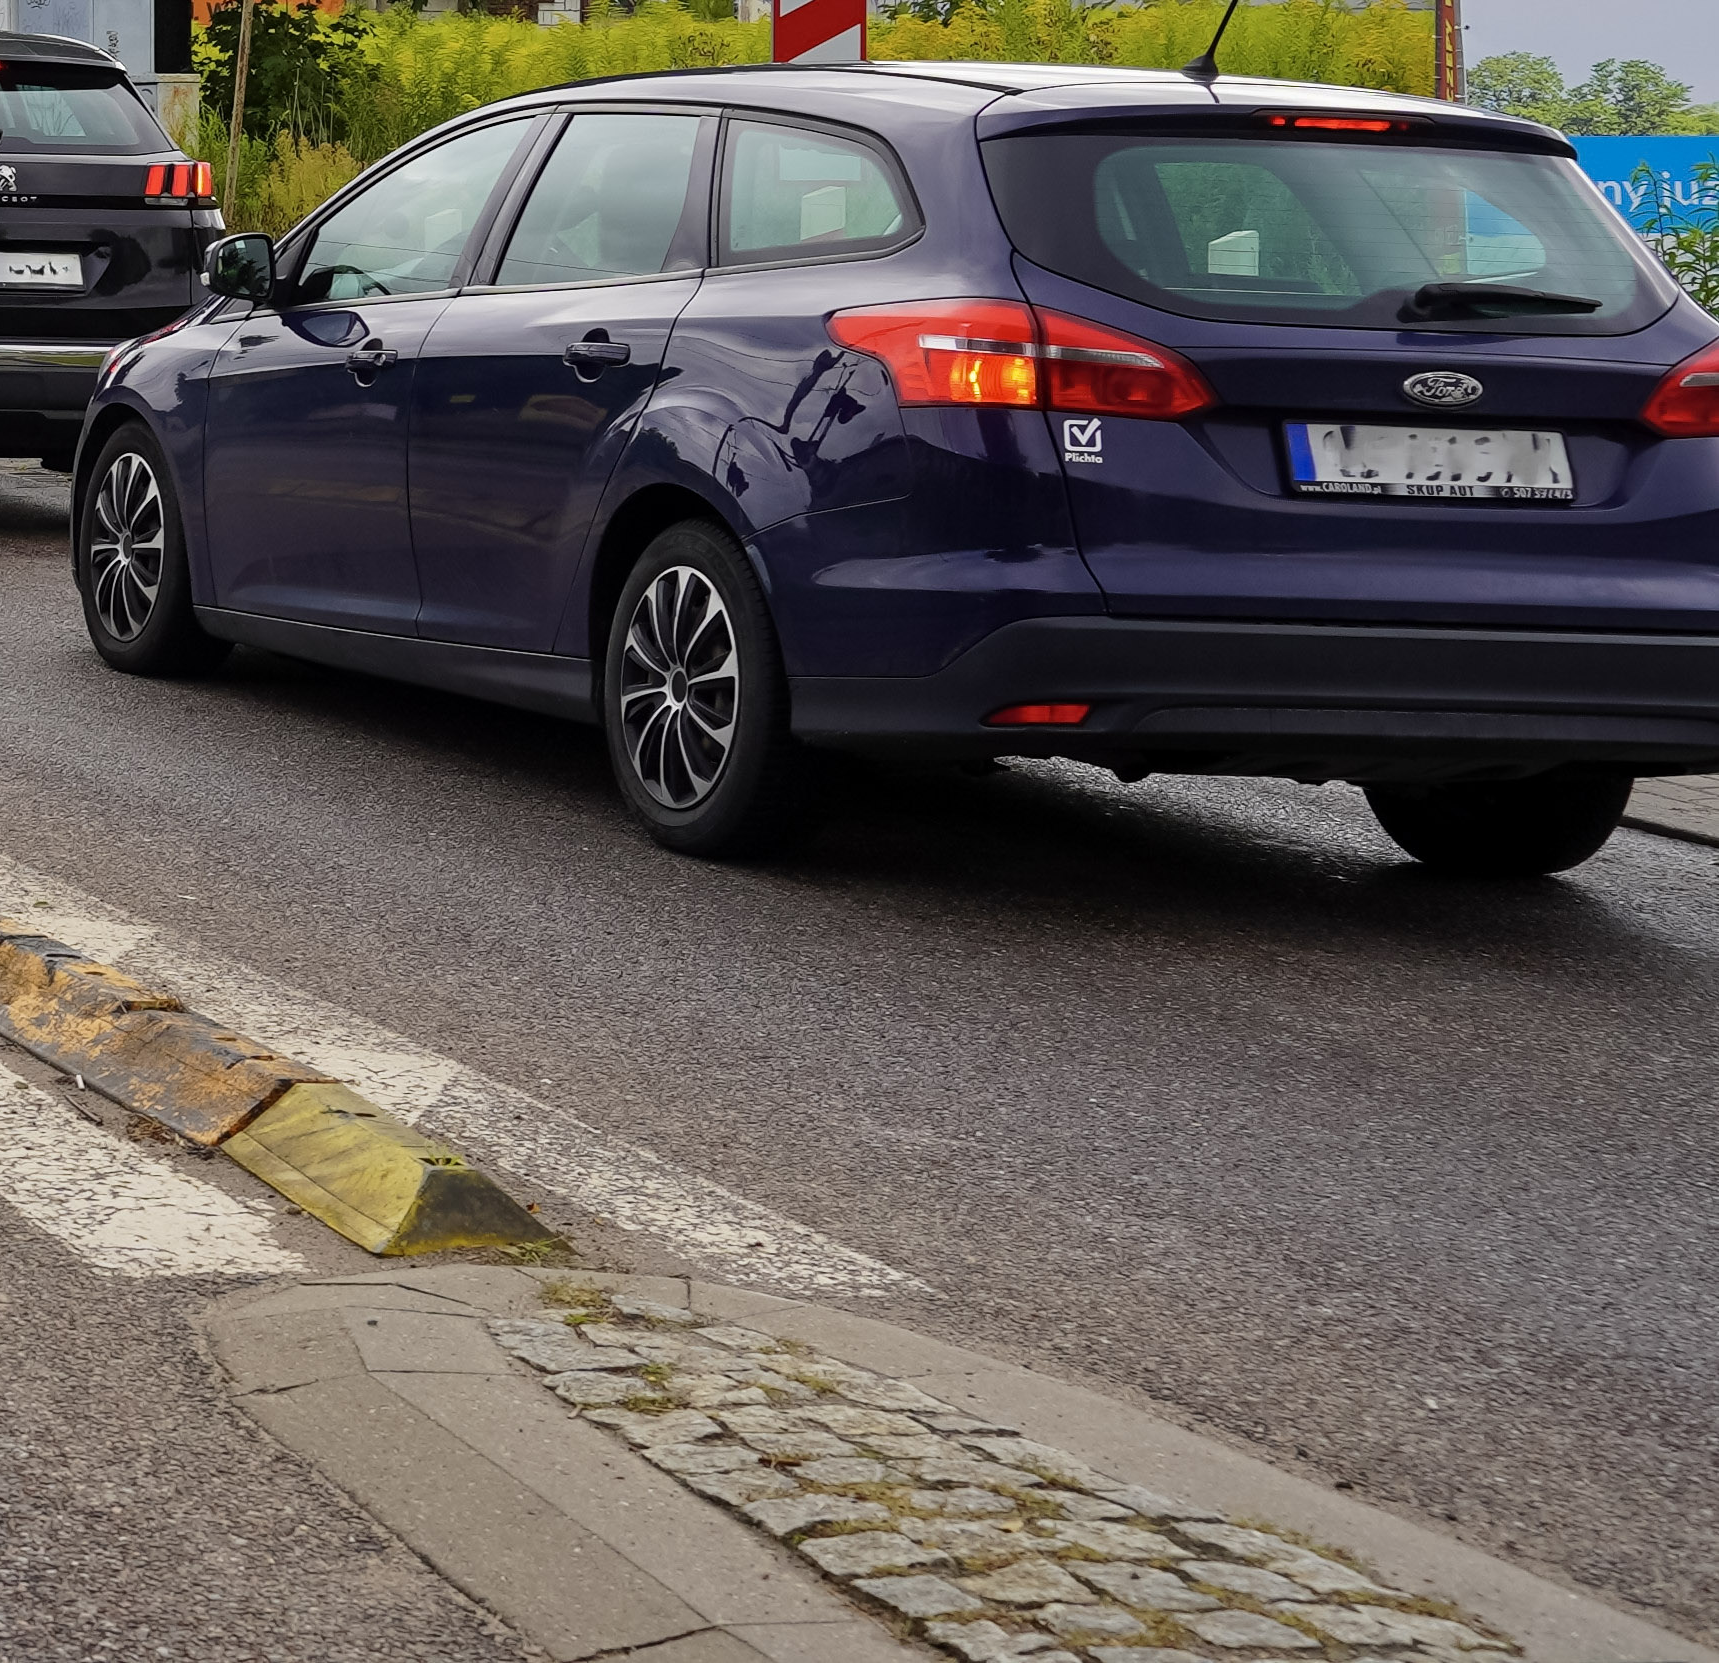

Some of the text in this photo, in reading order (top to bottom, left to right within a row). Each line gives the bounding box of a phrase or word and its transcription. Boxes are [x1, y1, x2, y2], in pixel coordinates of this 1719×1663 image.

[1064, 452, 1103, 464] Plichta
[1406, 484, 1445, 496] SKUP
[1448, 485, 1474, 497] AUT
